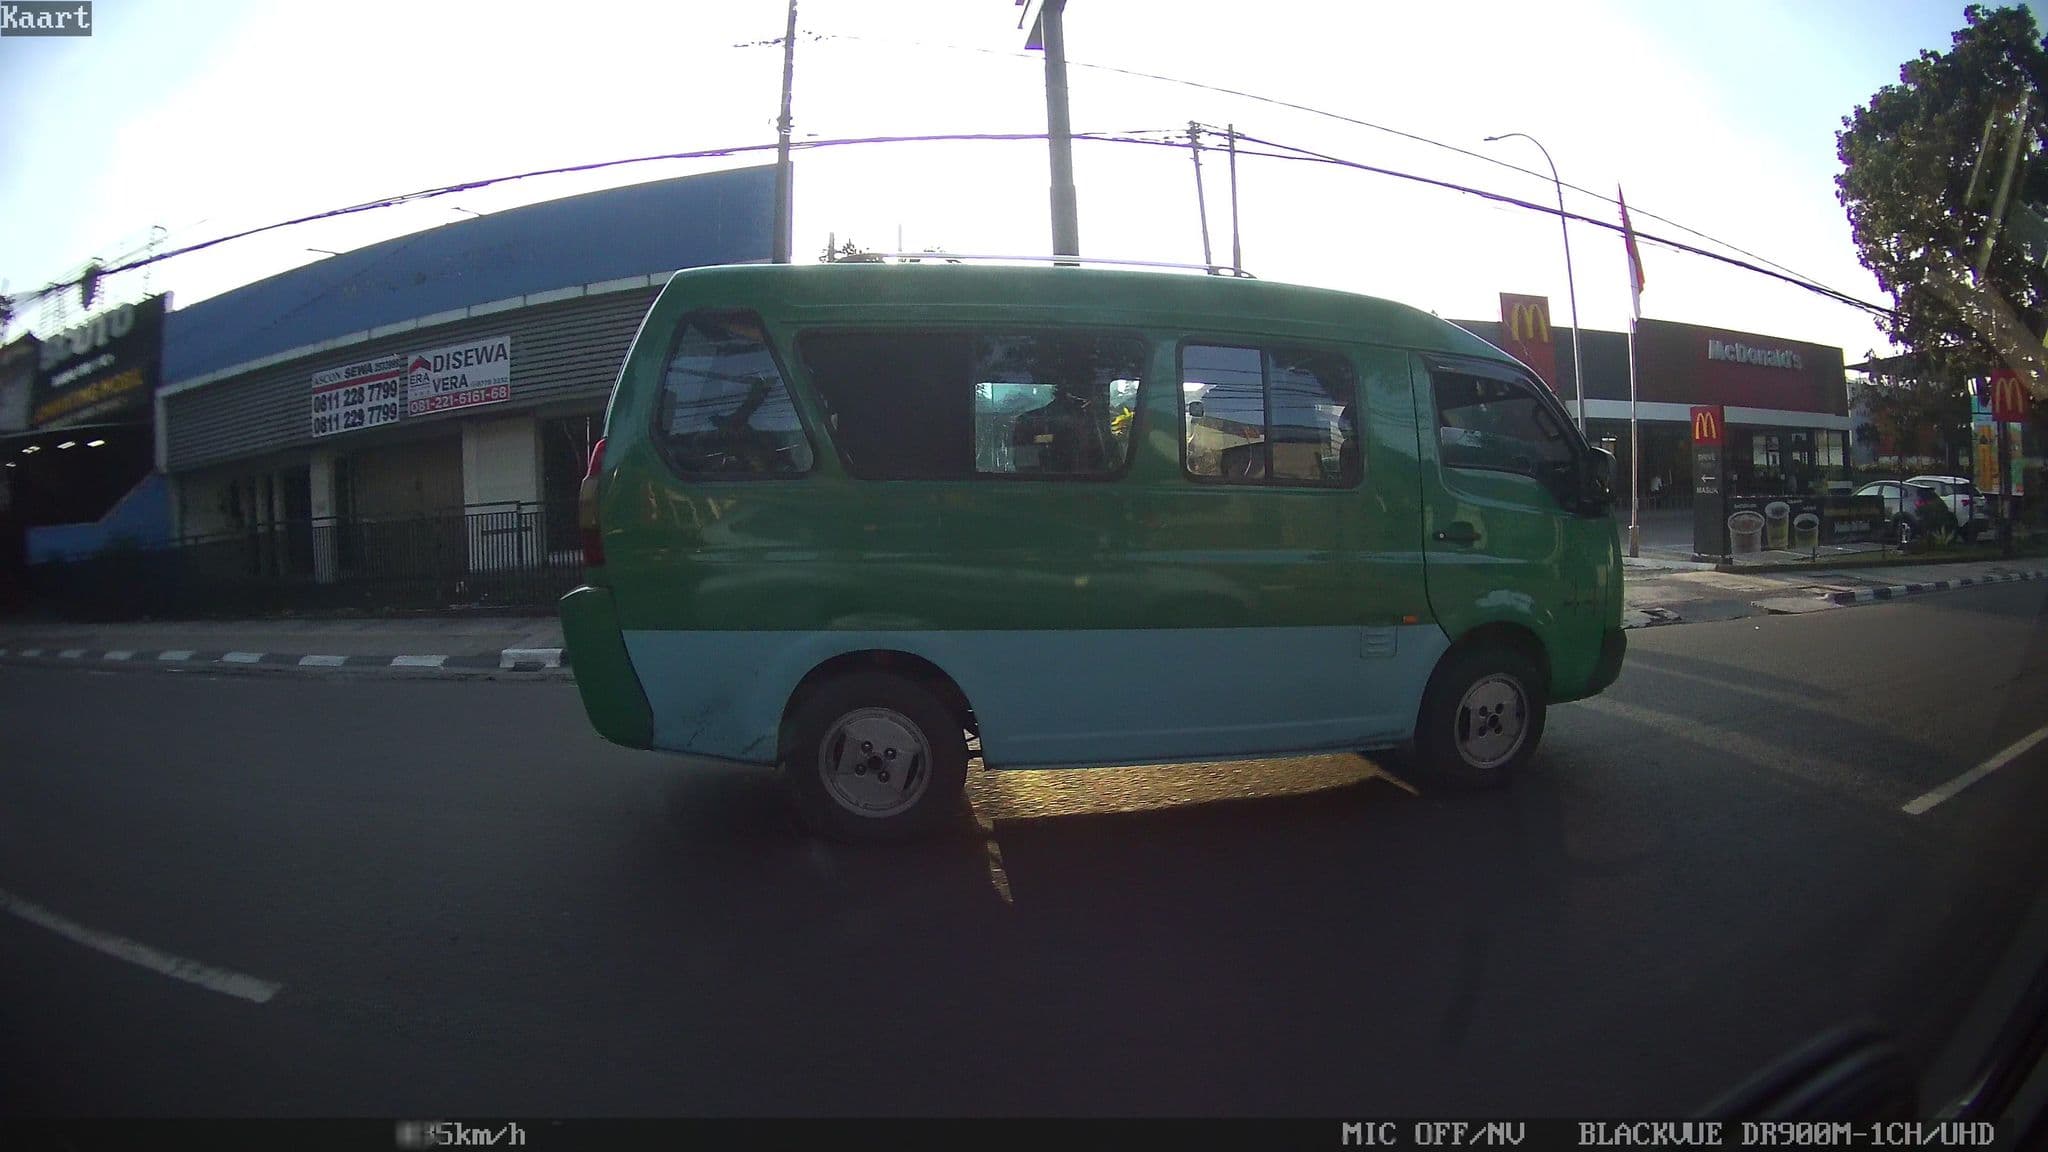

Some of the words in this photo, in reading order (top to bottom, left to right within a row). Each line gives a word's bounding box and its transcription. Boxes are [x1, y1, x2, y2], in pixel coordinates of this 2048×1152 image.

[433, 343, 508, 373] DISEWA
[1707, 339, 1802, 370] McDonald's
[344, 362, 373, 378] SEWA
[410, 372, 430, 385] ERA
[432, 374, 468, 393] VERA
[314, 392, 340, 413] 0811
[344, 387, 365, 407] 228
[368, 380, 398, 402] 7799
[411, 386, 507, 413] 081-221-6161-68
[314, 414, 340, 434] 0811
[368, 402, 398, 424] 7799
